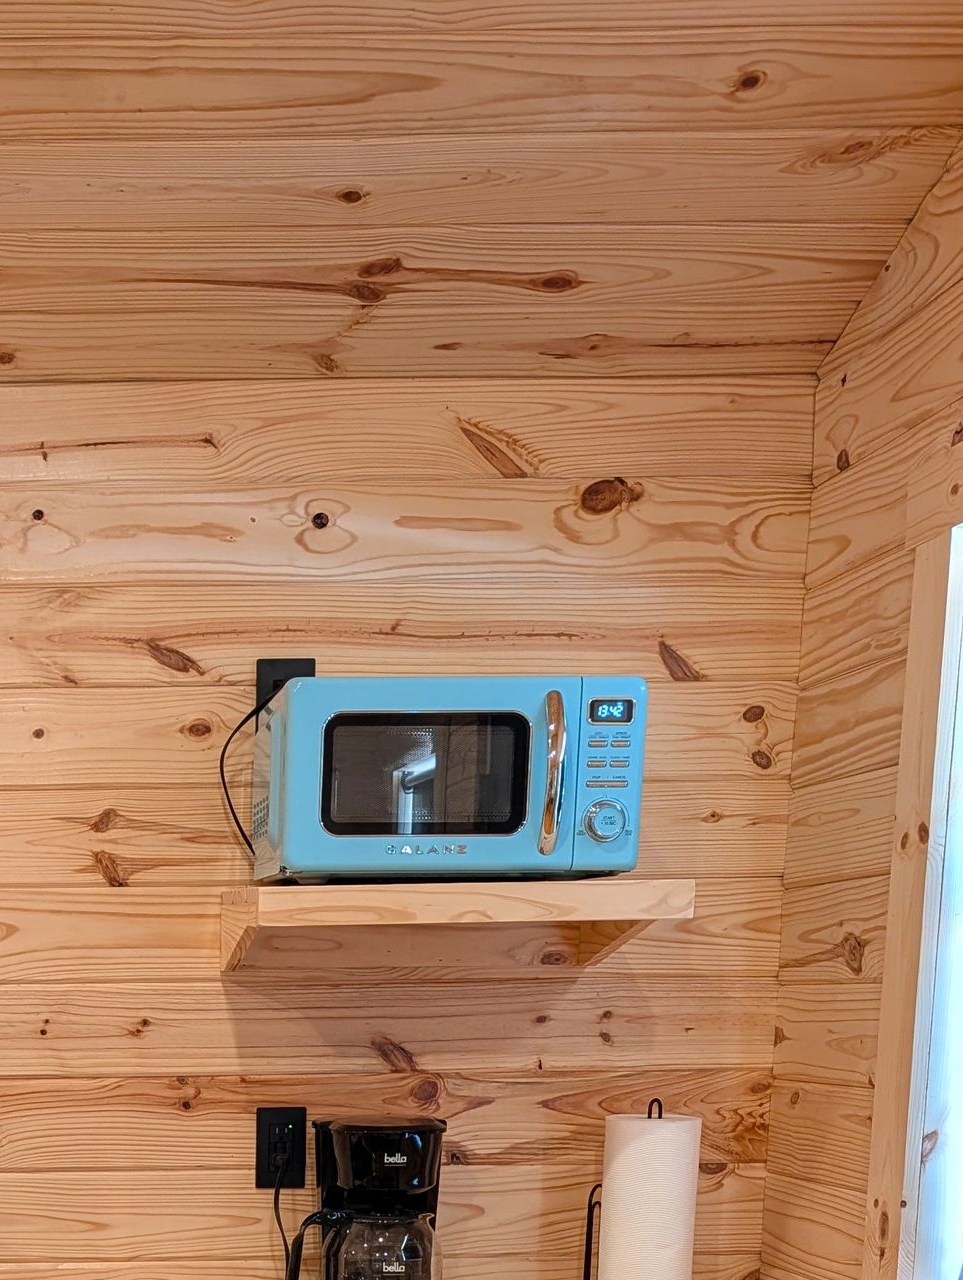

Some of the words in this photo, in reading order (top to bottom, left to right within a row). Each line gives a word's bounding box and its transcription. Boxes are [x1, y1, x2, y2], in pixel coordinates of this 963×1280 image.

[386, 844, 468, 855] GALANZ
[384, 1152, 407, 1163] bella
[382, 1261, 405, 1272] bella
